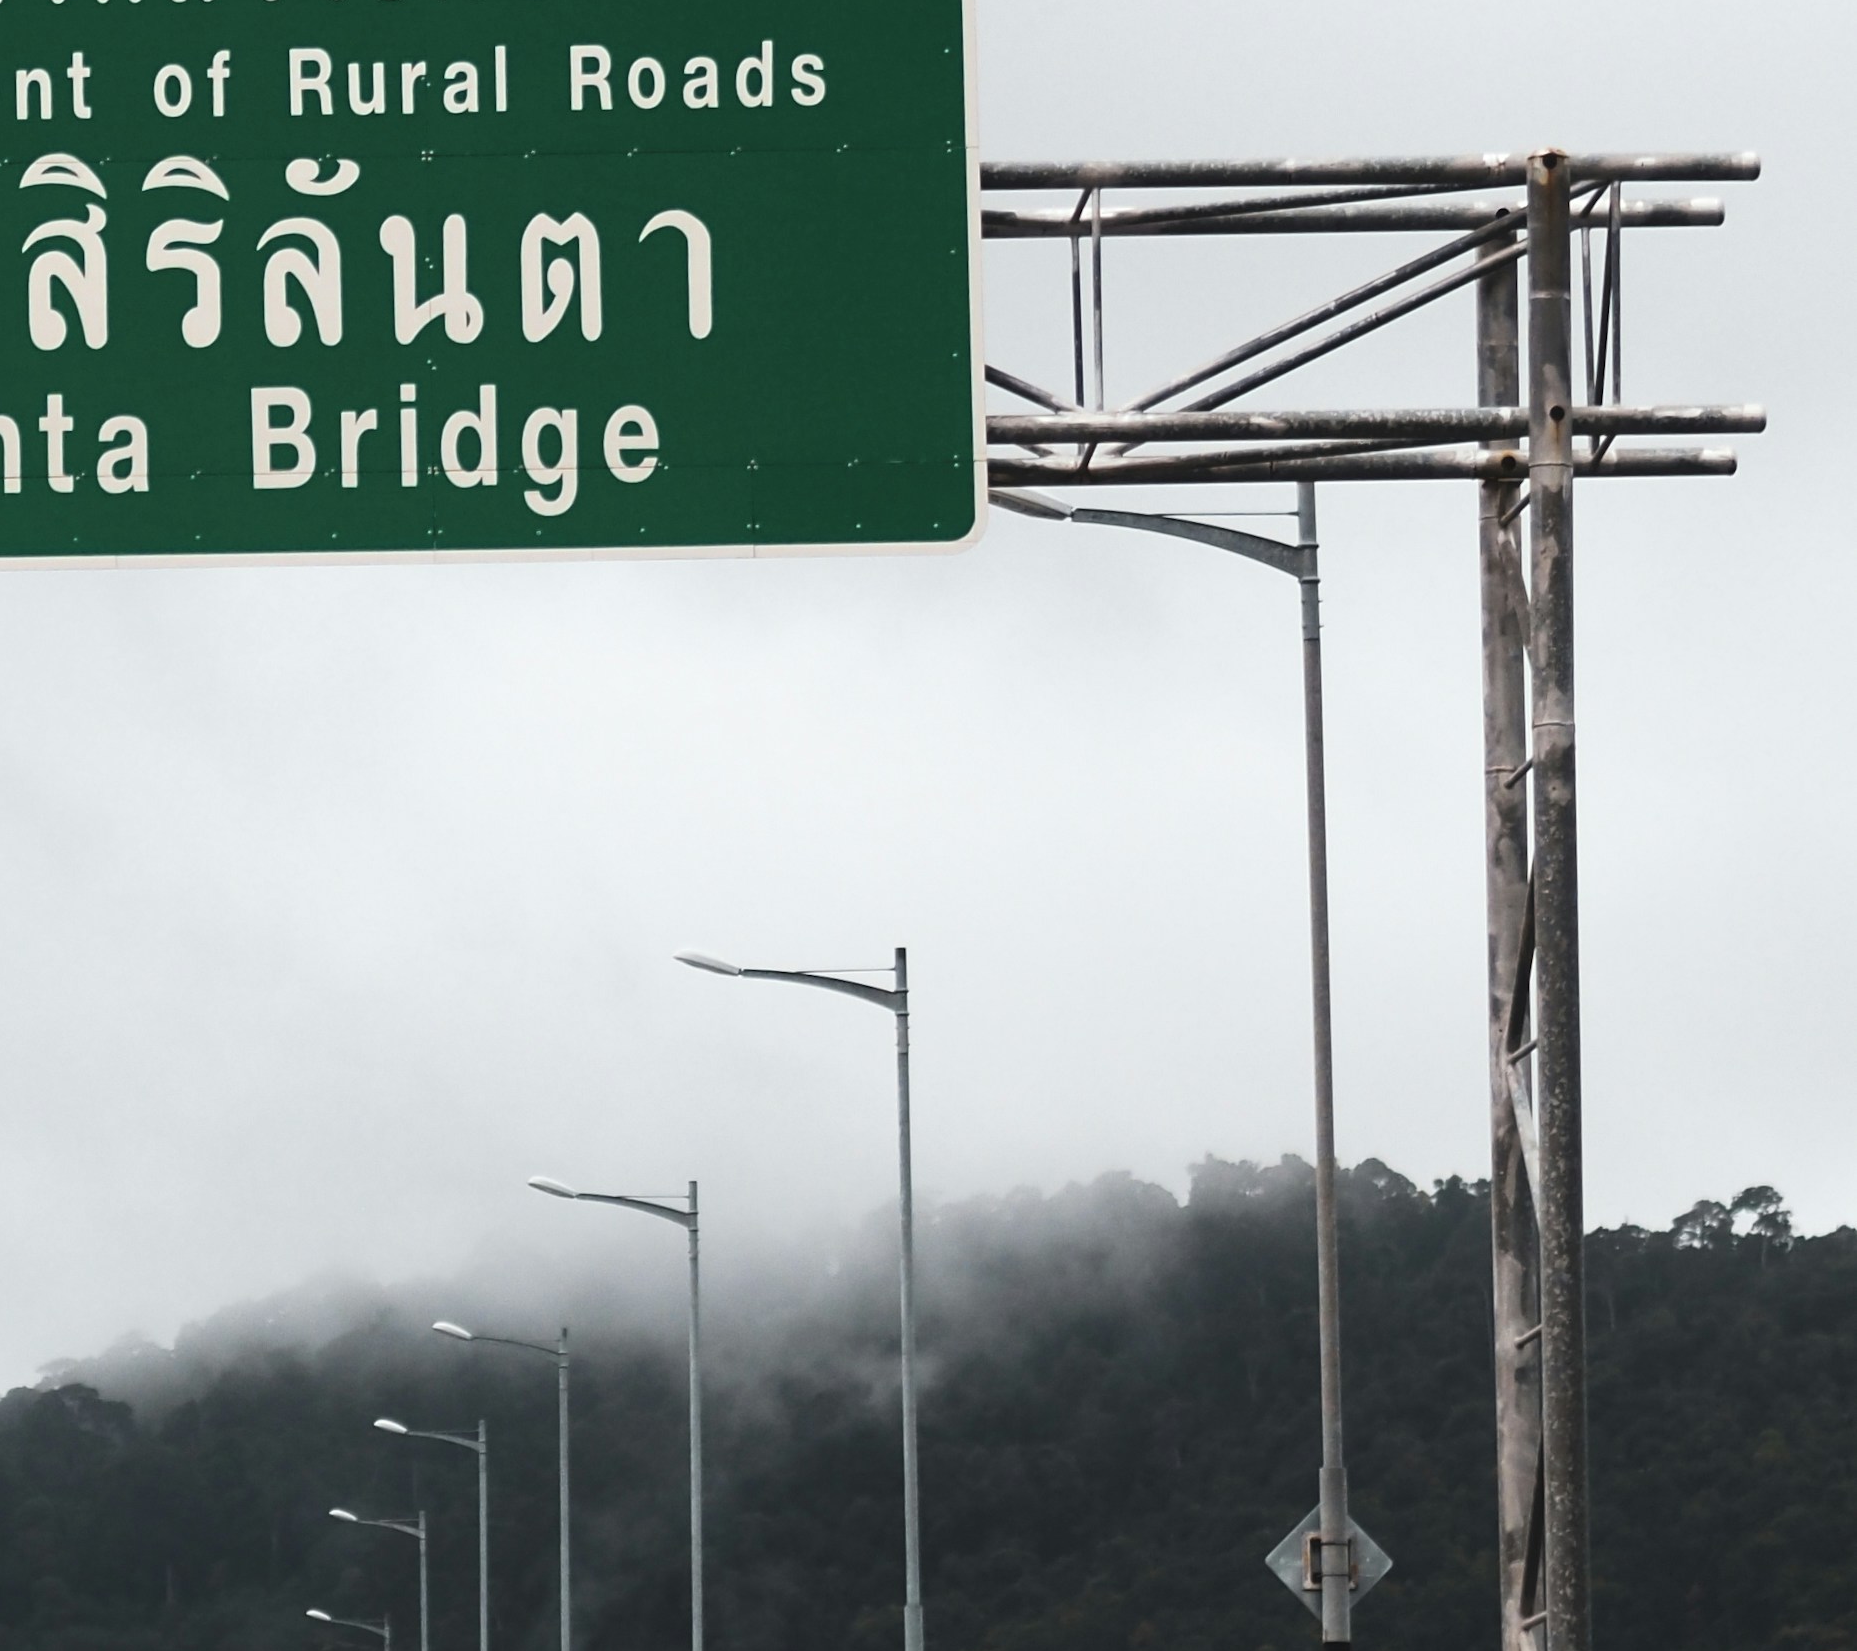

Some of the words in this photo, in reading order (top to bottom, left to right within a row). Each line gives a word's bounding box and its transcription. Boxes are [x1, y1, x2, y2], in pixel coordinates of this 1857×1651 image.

[152, 49, 231, 118] of
[288, 45, 508, 116] Rural
[569, 39, 827, 111] Roads
[250, 383, 660, 517] Bridge
